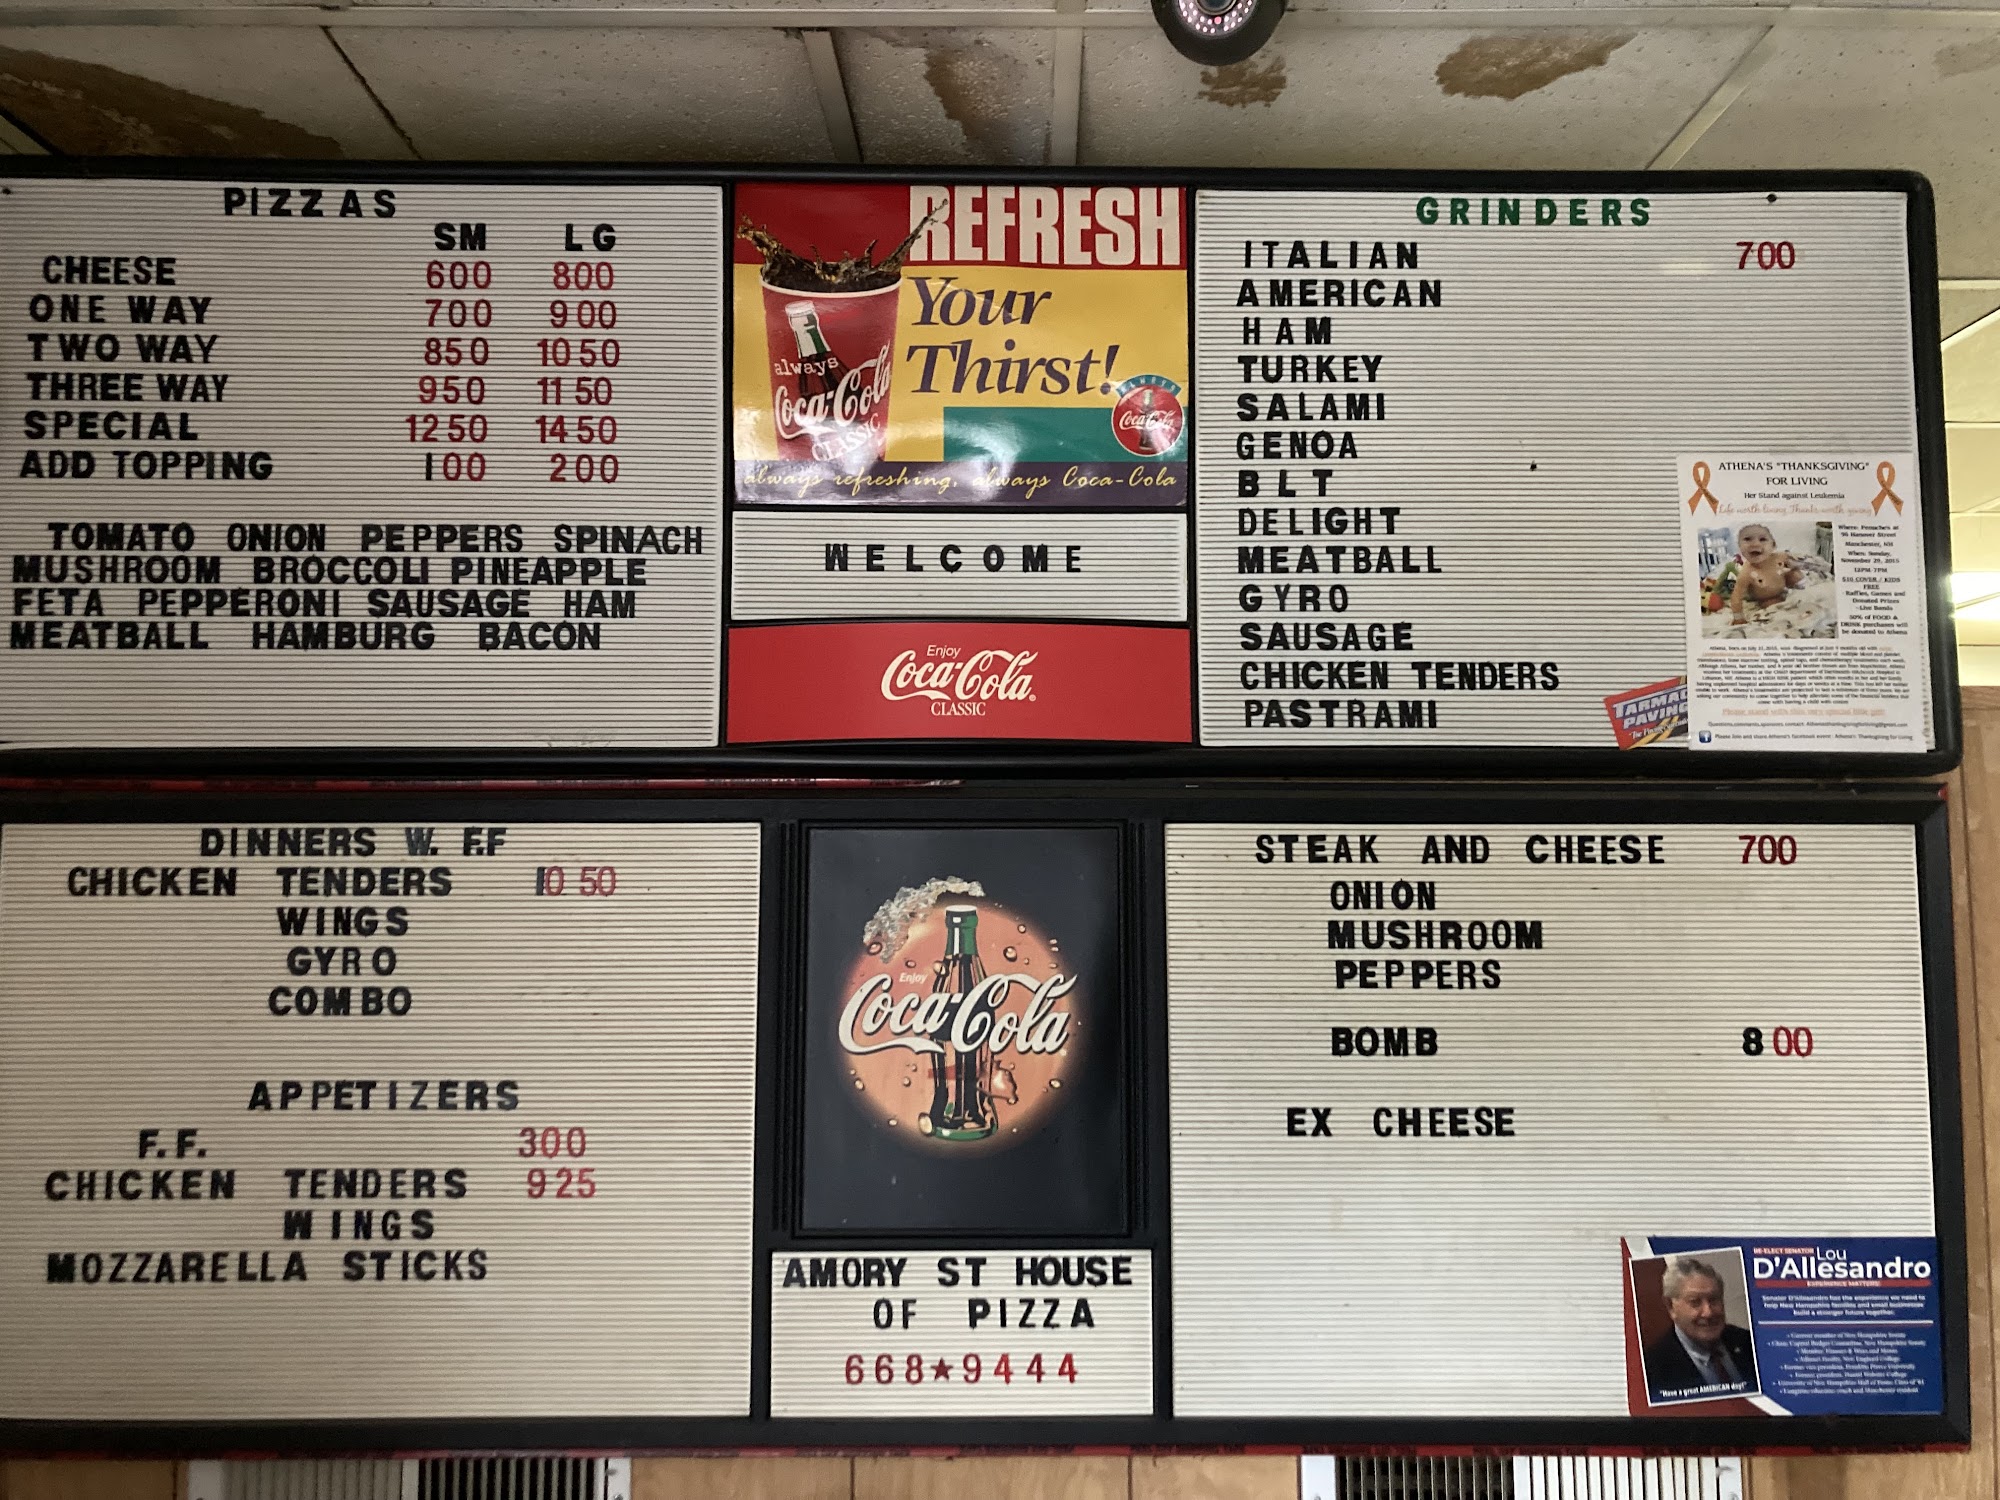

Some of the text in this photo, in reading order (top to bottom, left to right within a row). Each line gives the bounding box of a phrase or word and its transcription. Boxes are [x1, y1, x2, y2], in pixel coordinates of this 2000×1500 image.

[224, 187, 396, 220] PIZZAS
[1416, 198, 1651, 225] GRINDERS
[435, 223, 488, 253] SM
[909, 186, 1181, 266] REFRESH
[43, 255, 177, 287] CHEESE
[1245, 241, 1419, 271] ITALIAN
[1738, 240, 1797, 271] 700
[426, 260, 616, 292] 600 800
[906, 276, 1052, 327] Your
[1238, 279, 1442, 309] AMERICAN
[30, 294, 211, 326] ONE WAY
[427, 298, 494, 329] 700
[1244, 317, 1332, 347] HAM
[28, 333, 217, 366] TWO WAY
[424, 337, 491, 367] 850
[774, 356, 838, 376] always
[906, 338, 1120, 397] Thirst!
[1238, 355, 1382, 385] TURKEY
[27, 372, 229, 404] THREE WAY
[418, 374, 486, 406] 950
[1238, 392, 1386, 423] SALAMI
[25, 411, 199, 442] SPECIAL
[1237, 431, 1358, 461] GENOA
[21, 450, 274, 482] ADD TOPPING
[550, 452, 621, 484] 200
[1719, 462, 1773, 470] ATHENA'S
[1766, 477, 1828, 485] FOR LIVING
[744, 465, 822, 498] always
[973, 467, 1053, 500] always
[1062, 466, 1177, 489] Coca-Cola
[1239, 507, 1402, 538] DELIGHT
[48, 522, 703, 556] TOMATO ONION PEPPERS SPINACH
[13, 556, 648, 587] MUSHROOM BROCCOLI PINEAPPLE
[826, 544, 1082, 575] WELCOME
[1239, 545, 1442, 576] MEATBALL
[14, 587, 637, 619] FETA PEPPERONI SAUSAGE HAM
[1239, 584, 1350, 614] GYRO
[11, 622, 601, 653] MEATBALL HAMBURG BACON
[927, 645, 961, 659] Enjoy
[1241, 622, 1414, 653] SAUSAGE
[881, 650, 1038, 701] Coca-Cola
[1241, 661, 1560, 692] CHICKEN TENDERS
[931, 702, 986, 716] CLASSIC
[1245, 699, 1438, 730] PASTRAMI
[201, 827, 376, 859] DINNERS
[406, 828, 439, 858] W.
[1257, 835, 1664, 866] STEAK AND CHEESE
[1740, 834, 1799, 867] 700
[69, 867, 453, 899] CHICKEN TENDERS
[1331, 881, 1437, 912] ONION
[277, 907, 409, 938] WINGS
[1328, 920, 1544, 951] MUSHROOM
[288, 947, 398, 978] GYRO
[1336, 960, 1502, 991] PEPPERS
[899, 972, 929, 985] Enjoy
[269, 986, 413, 1018] COMBO
[838, 973, 1077, 1054] Coca-Cola
[1332, 1027, 1439, 1058] BOMB
[249, 1080, 519, 1112] APPETIZERS
[1287, 1107, 1515, 1139] EX CHEESE
[518, 1125, 588, 1159] 300
[46, 1168, 467, 1203] CHICKEN TENDERS
[284, 1209, 435, 1242] WINGS
[48, 1250, 487, 1285] MOZZARELLA STICKS
[1754, 1256, 1930, 1279] D'Allesandro
[1817, 1246, 1846, 1260] Lou
[784, 1256, 1133, 1289] AMORY ST HOUSE
[874, 1298, 1095, 1331] OF PIZZA
